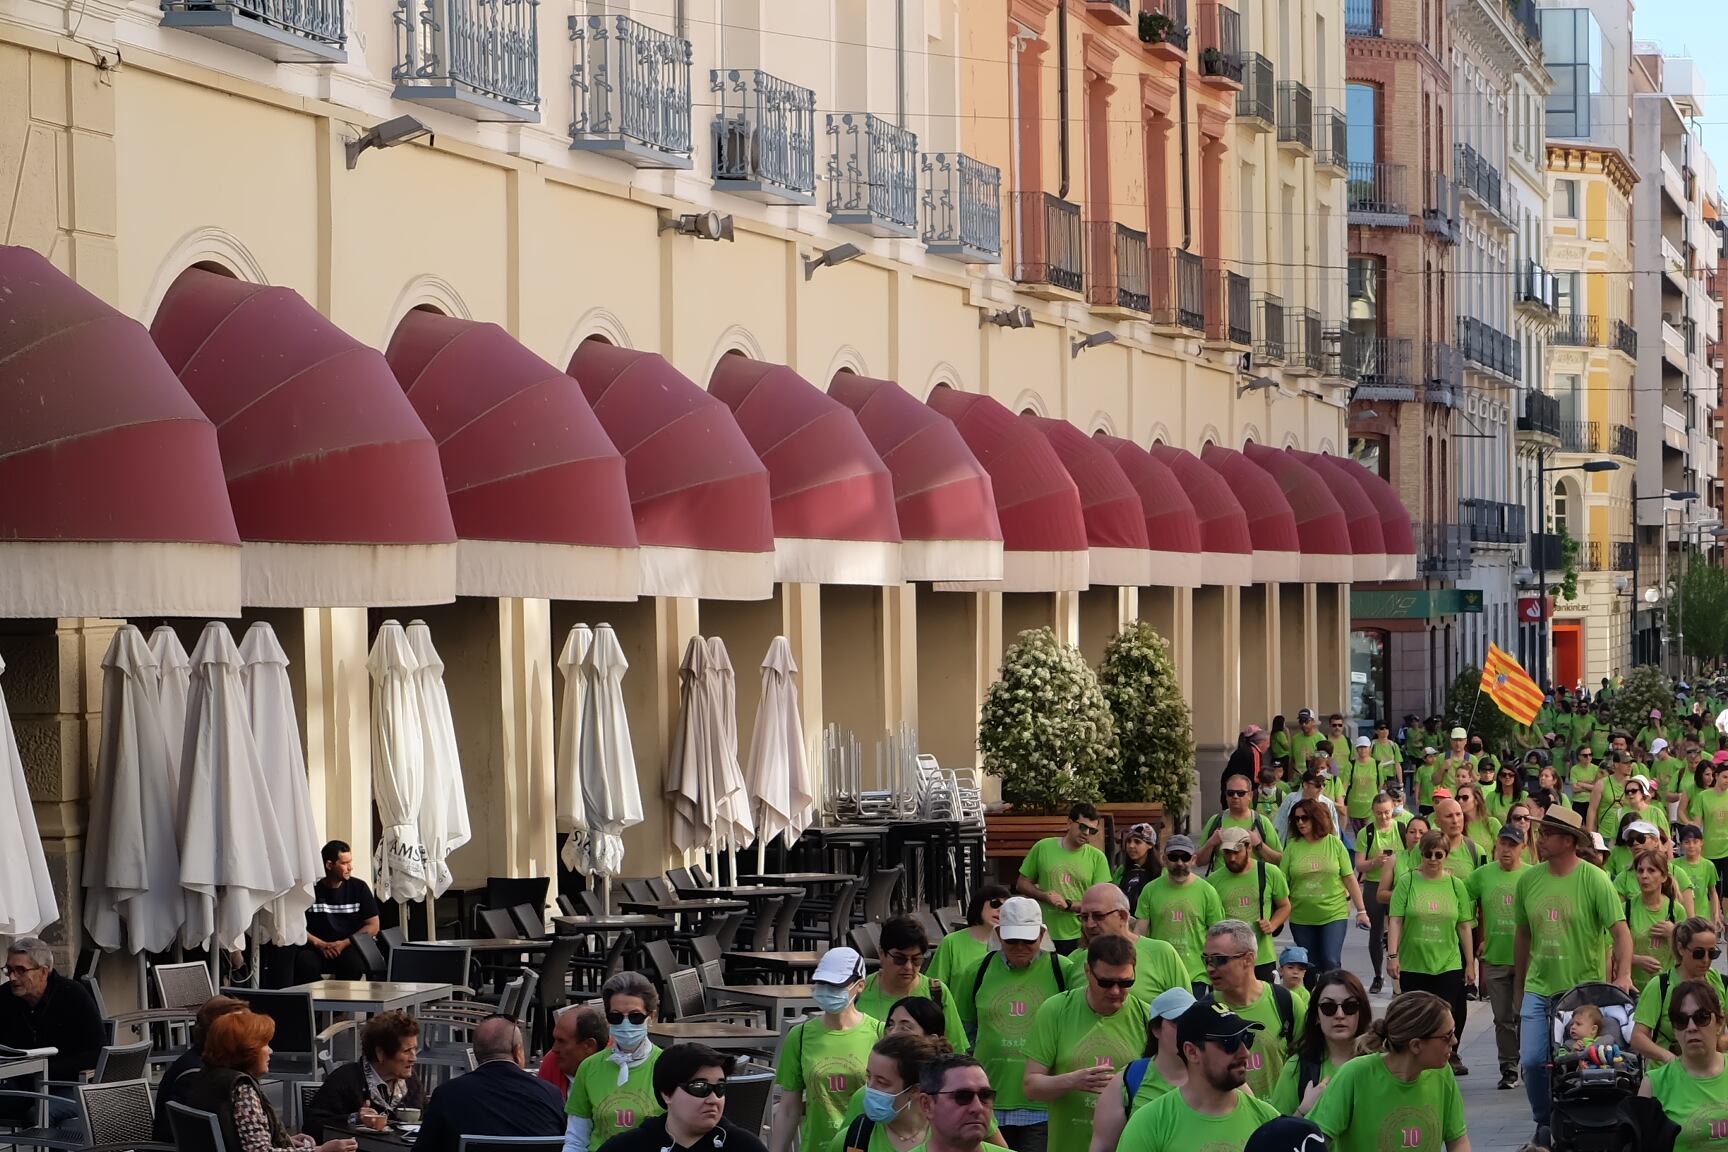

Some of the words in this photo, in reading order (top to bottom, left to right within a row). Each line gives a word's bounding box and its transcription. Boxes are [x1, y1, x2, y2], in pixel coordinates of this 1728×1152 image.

[1011, 1001, 1027, 1016] 10
[829, 1074, 847, 1092] 10
[616, 1109, 635, 1128] 10
[1402, 1126, 1422, 1148] 10
